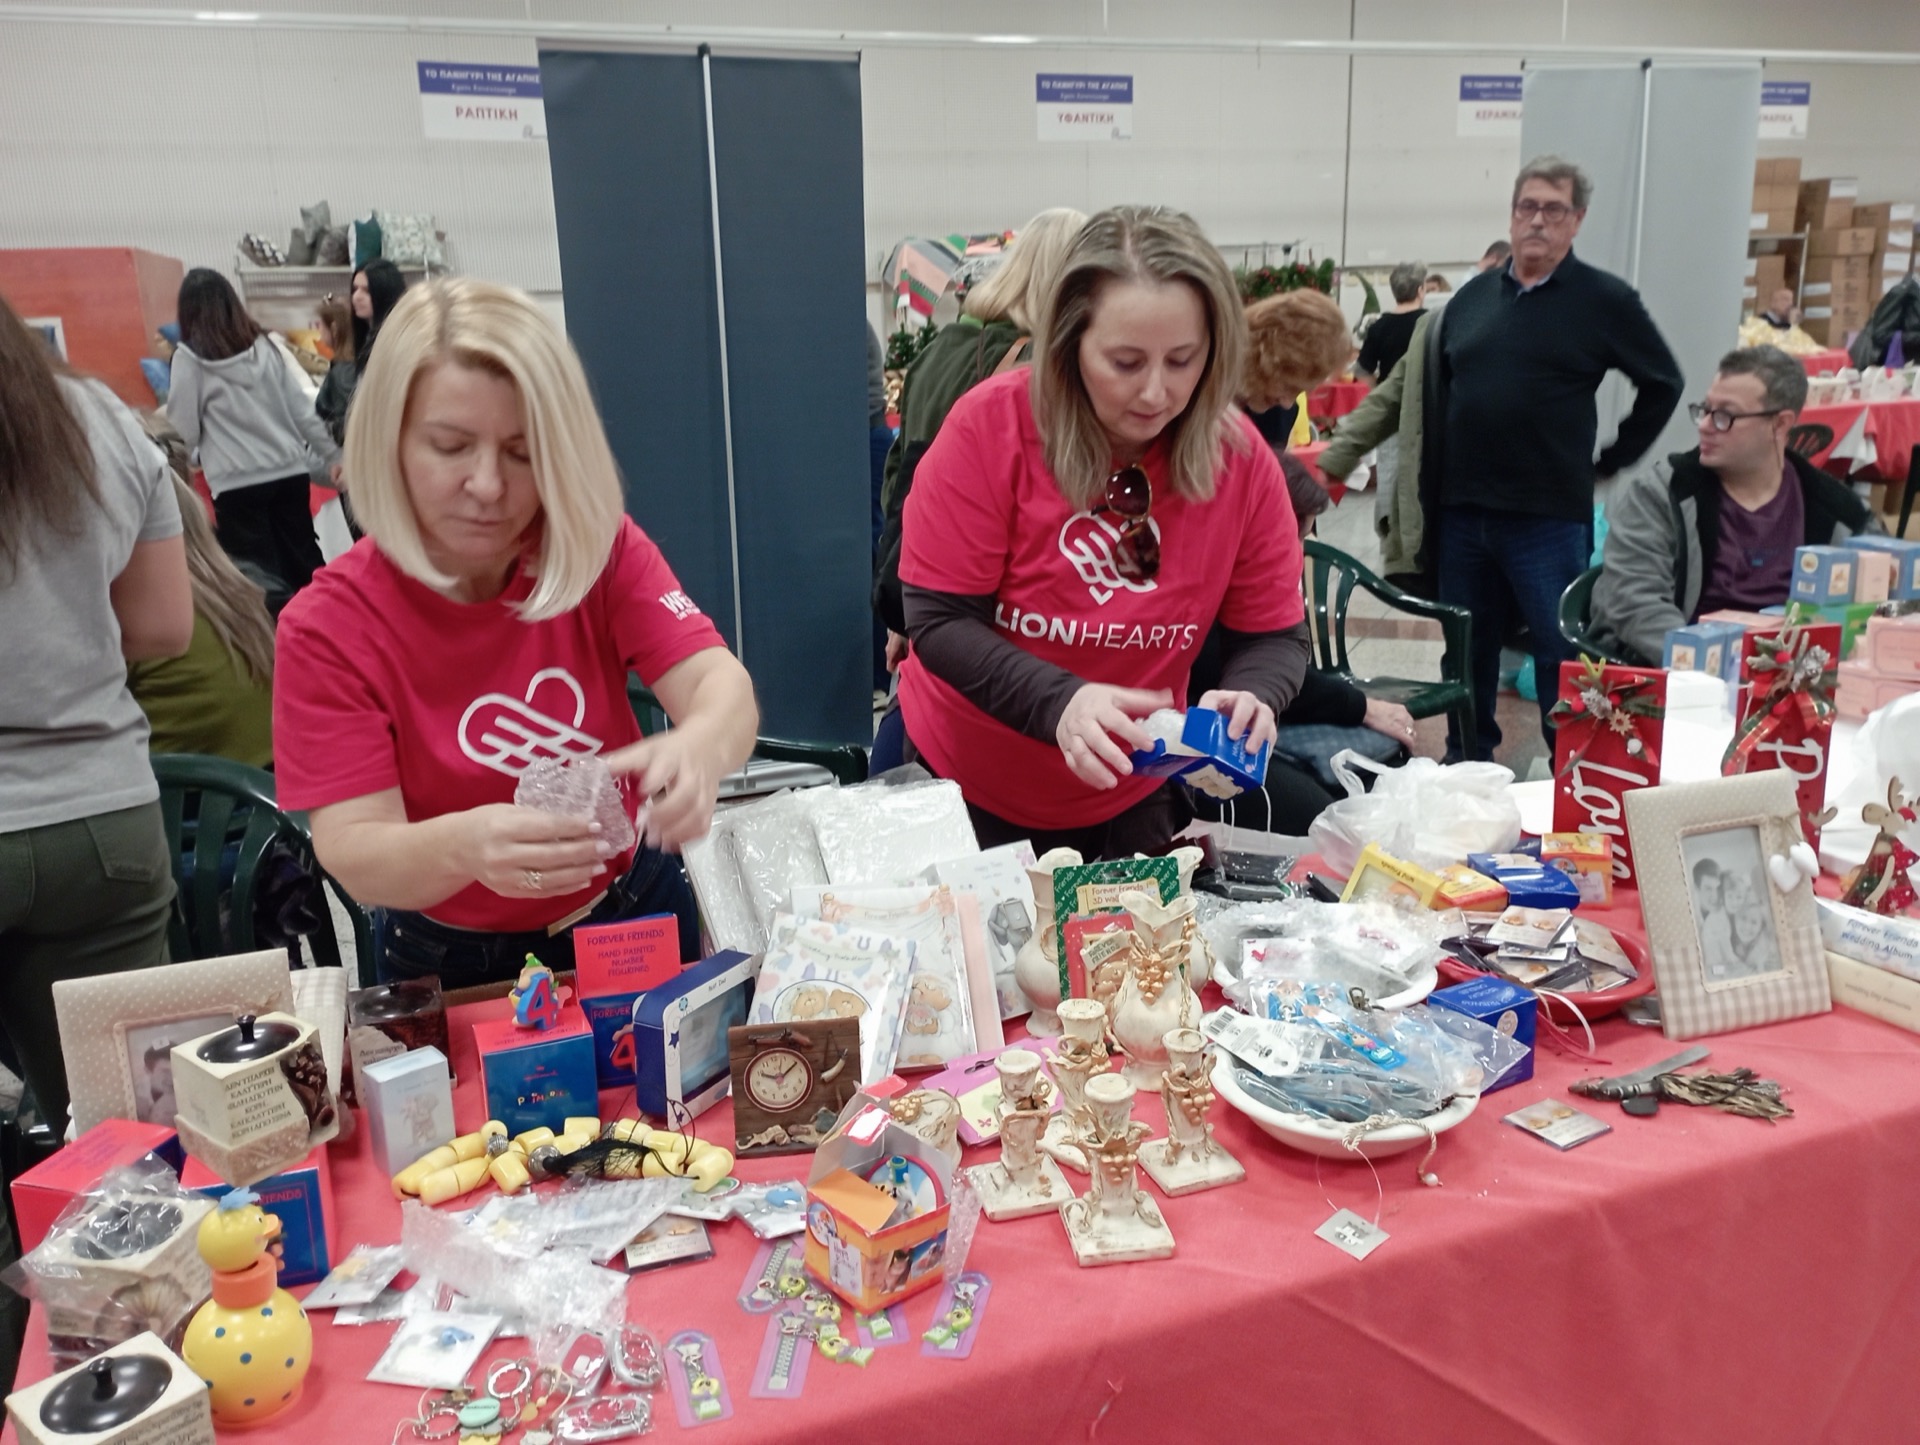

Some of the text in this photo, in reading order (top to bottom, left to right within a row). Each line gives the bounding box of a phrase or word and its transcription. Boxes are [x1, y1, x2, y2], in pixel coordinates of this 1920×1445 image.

[455, 106, 518, 120] ΡΑΠΤΙΚΗ
[1058, 112, 1114, 123] ΥΦΑΝΤΙΚΗ
[1092, 886, 1117, 896] Forever
[1092, 897, 1103, 906] 3D
[587, 929, 665, 946] FOREVER FRIENDS
[1847, 918, 1919, 948] Forever Friends
[598, 944, 657, 959] HAND PAINTED
[1882, 944, 1914, 960] Album
[611, 955, 644, 967] NUMBER
[608, 965, 650, 977] FIGURINES
[593, 1007, 631, 1019] FOREVER
[259, 1188, 303, 1205] RIENDS
